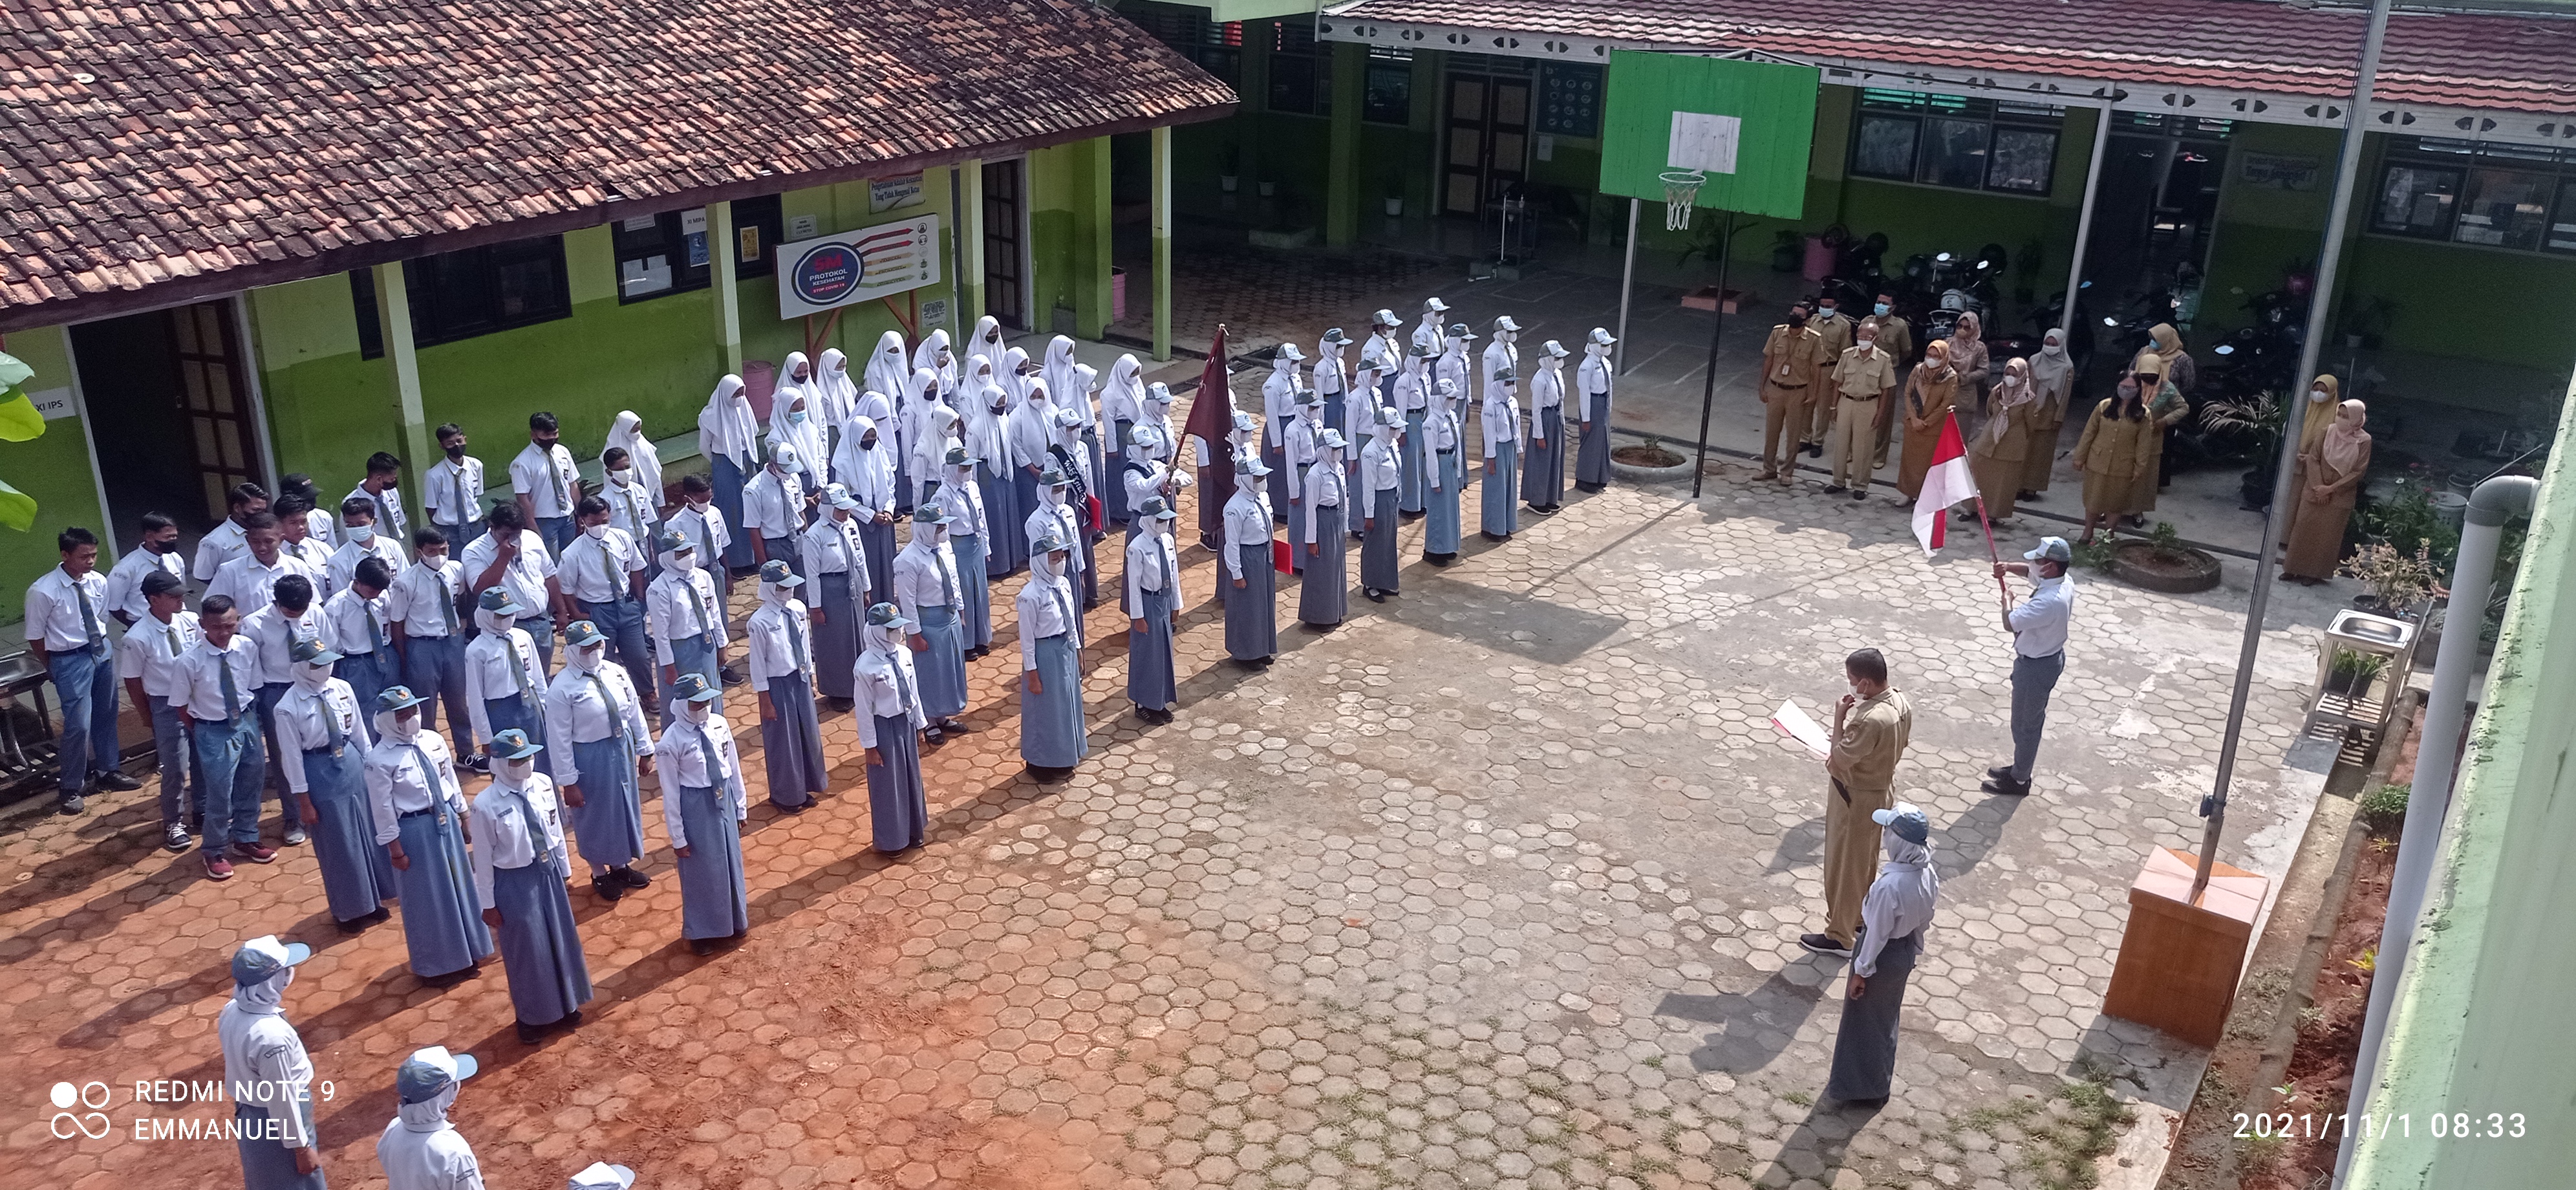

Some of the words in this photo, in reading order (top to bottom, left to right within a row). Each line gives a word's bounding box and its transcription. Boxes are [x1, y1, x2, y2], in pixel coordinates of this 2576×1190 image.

[815, 254, 843, 272] 5M
[810, 268, 848, 282] PROTOKOL
[813, 276, 845, 287] KESEHATAN
[36, 403, 46, 412] XI
[48, 400, 63, 409] IPS
